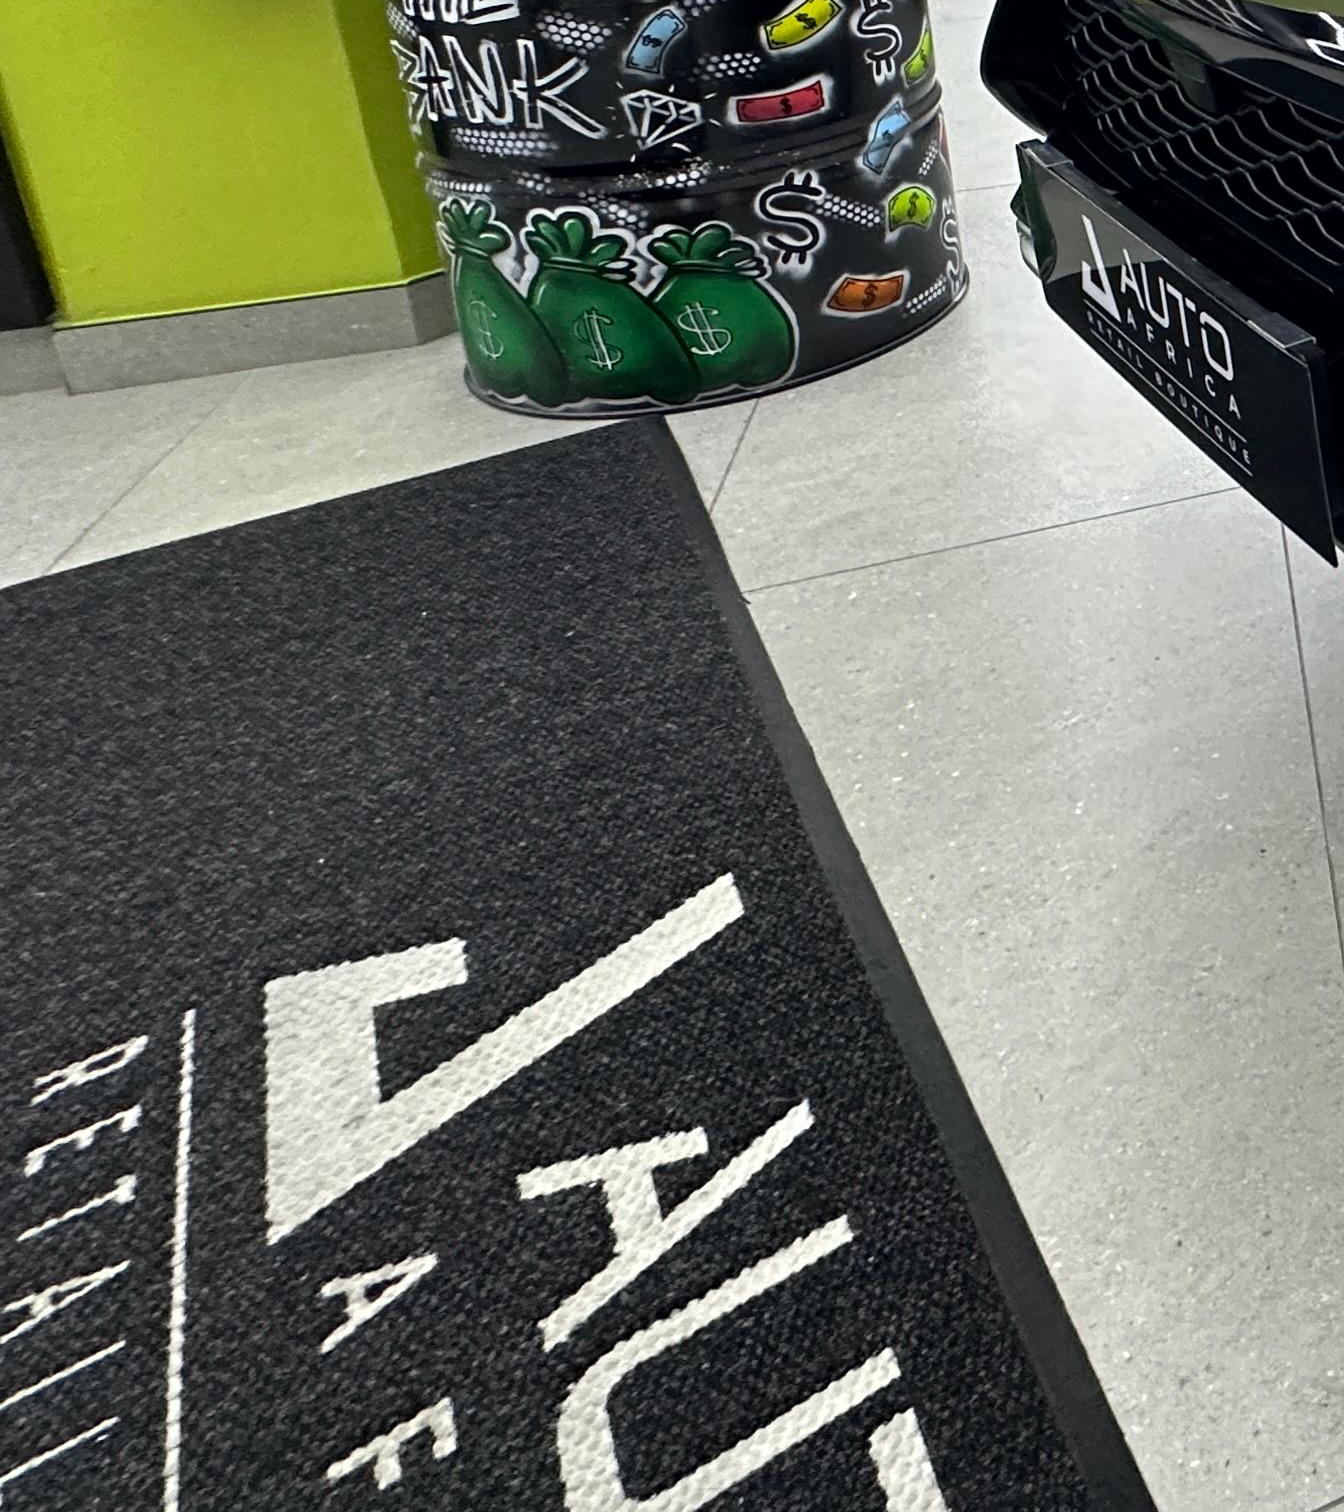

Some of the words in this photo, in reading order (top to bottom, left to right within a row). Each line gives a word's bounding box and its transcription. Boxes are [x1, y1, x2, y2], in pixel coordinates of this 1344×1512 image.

[1120, 248, 1234, 382] AUTO
[1126, 307, 1242, 420] AFRICA
[1086, 310, 1144, 370] RETAIL
[1154, 371, 1252, 466] BOUTIQUE
[516, 1098, 950, 1512] AU
